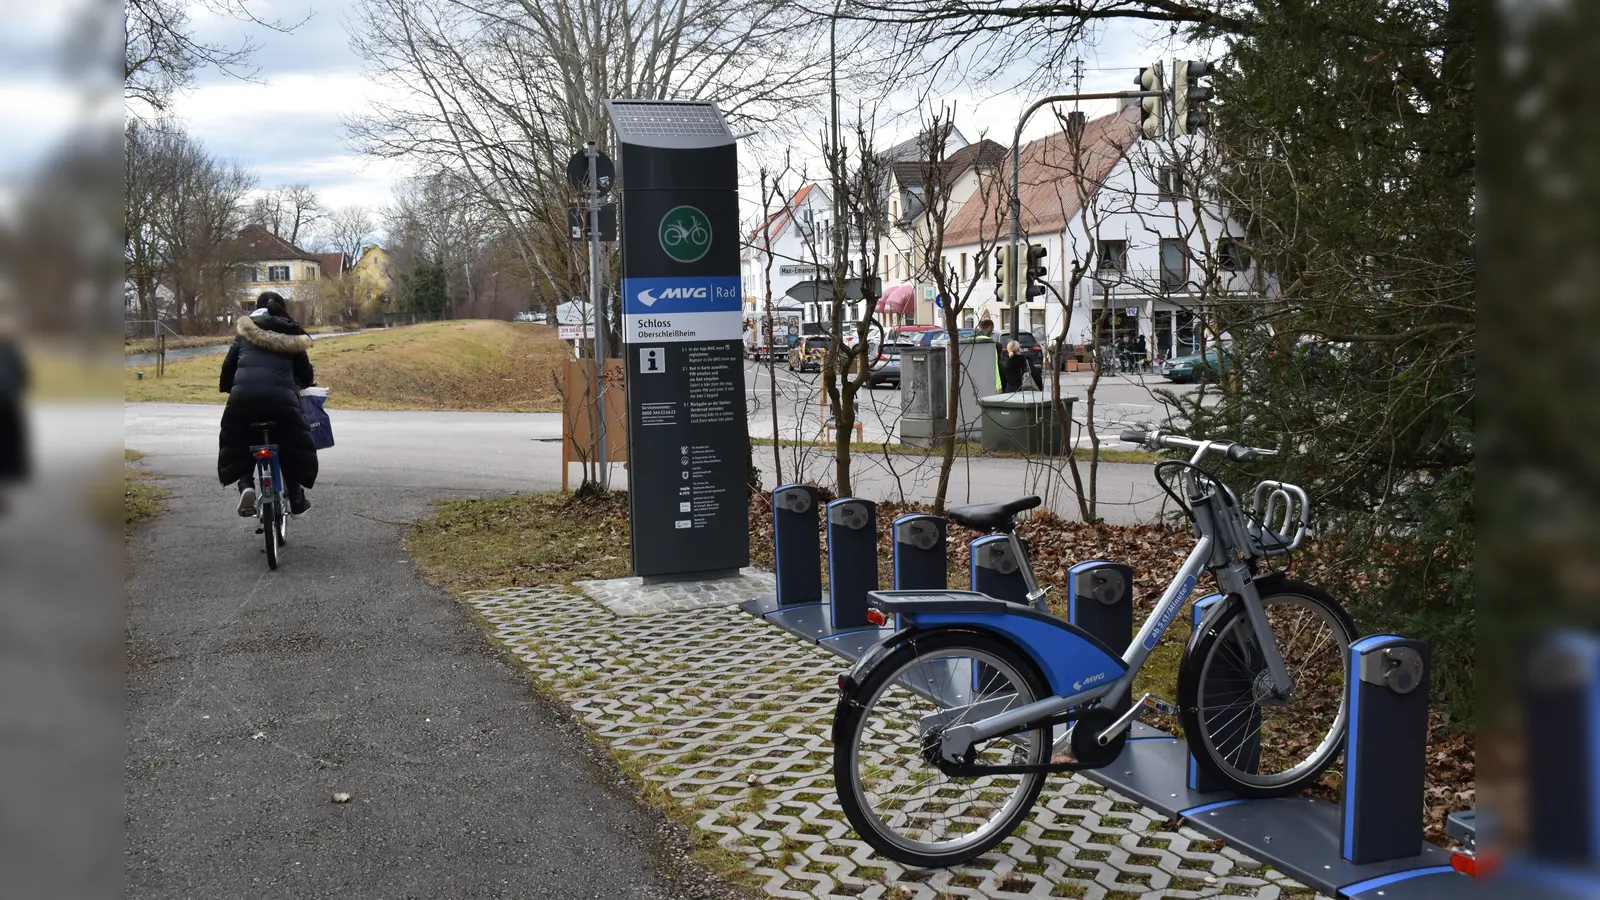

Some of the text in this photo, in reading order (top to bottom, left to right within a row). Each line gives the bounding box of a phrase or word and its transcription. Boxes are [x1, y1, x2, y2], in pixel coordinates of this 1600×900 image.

[659, 286, 735, 298] MVG Rad
[638, 319, 671, 328] Schloss
[638, 330, 696, 338] Oberschleißheim
[1152, 628, 1160, 638] ab
[1083, 672, 1104, 685] MVG
